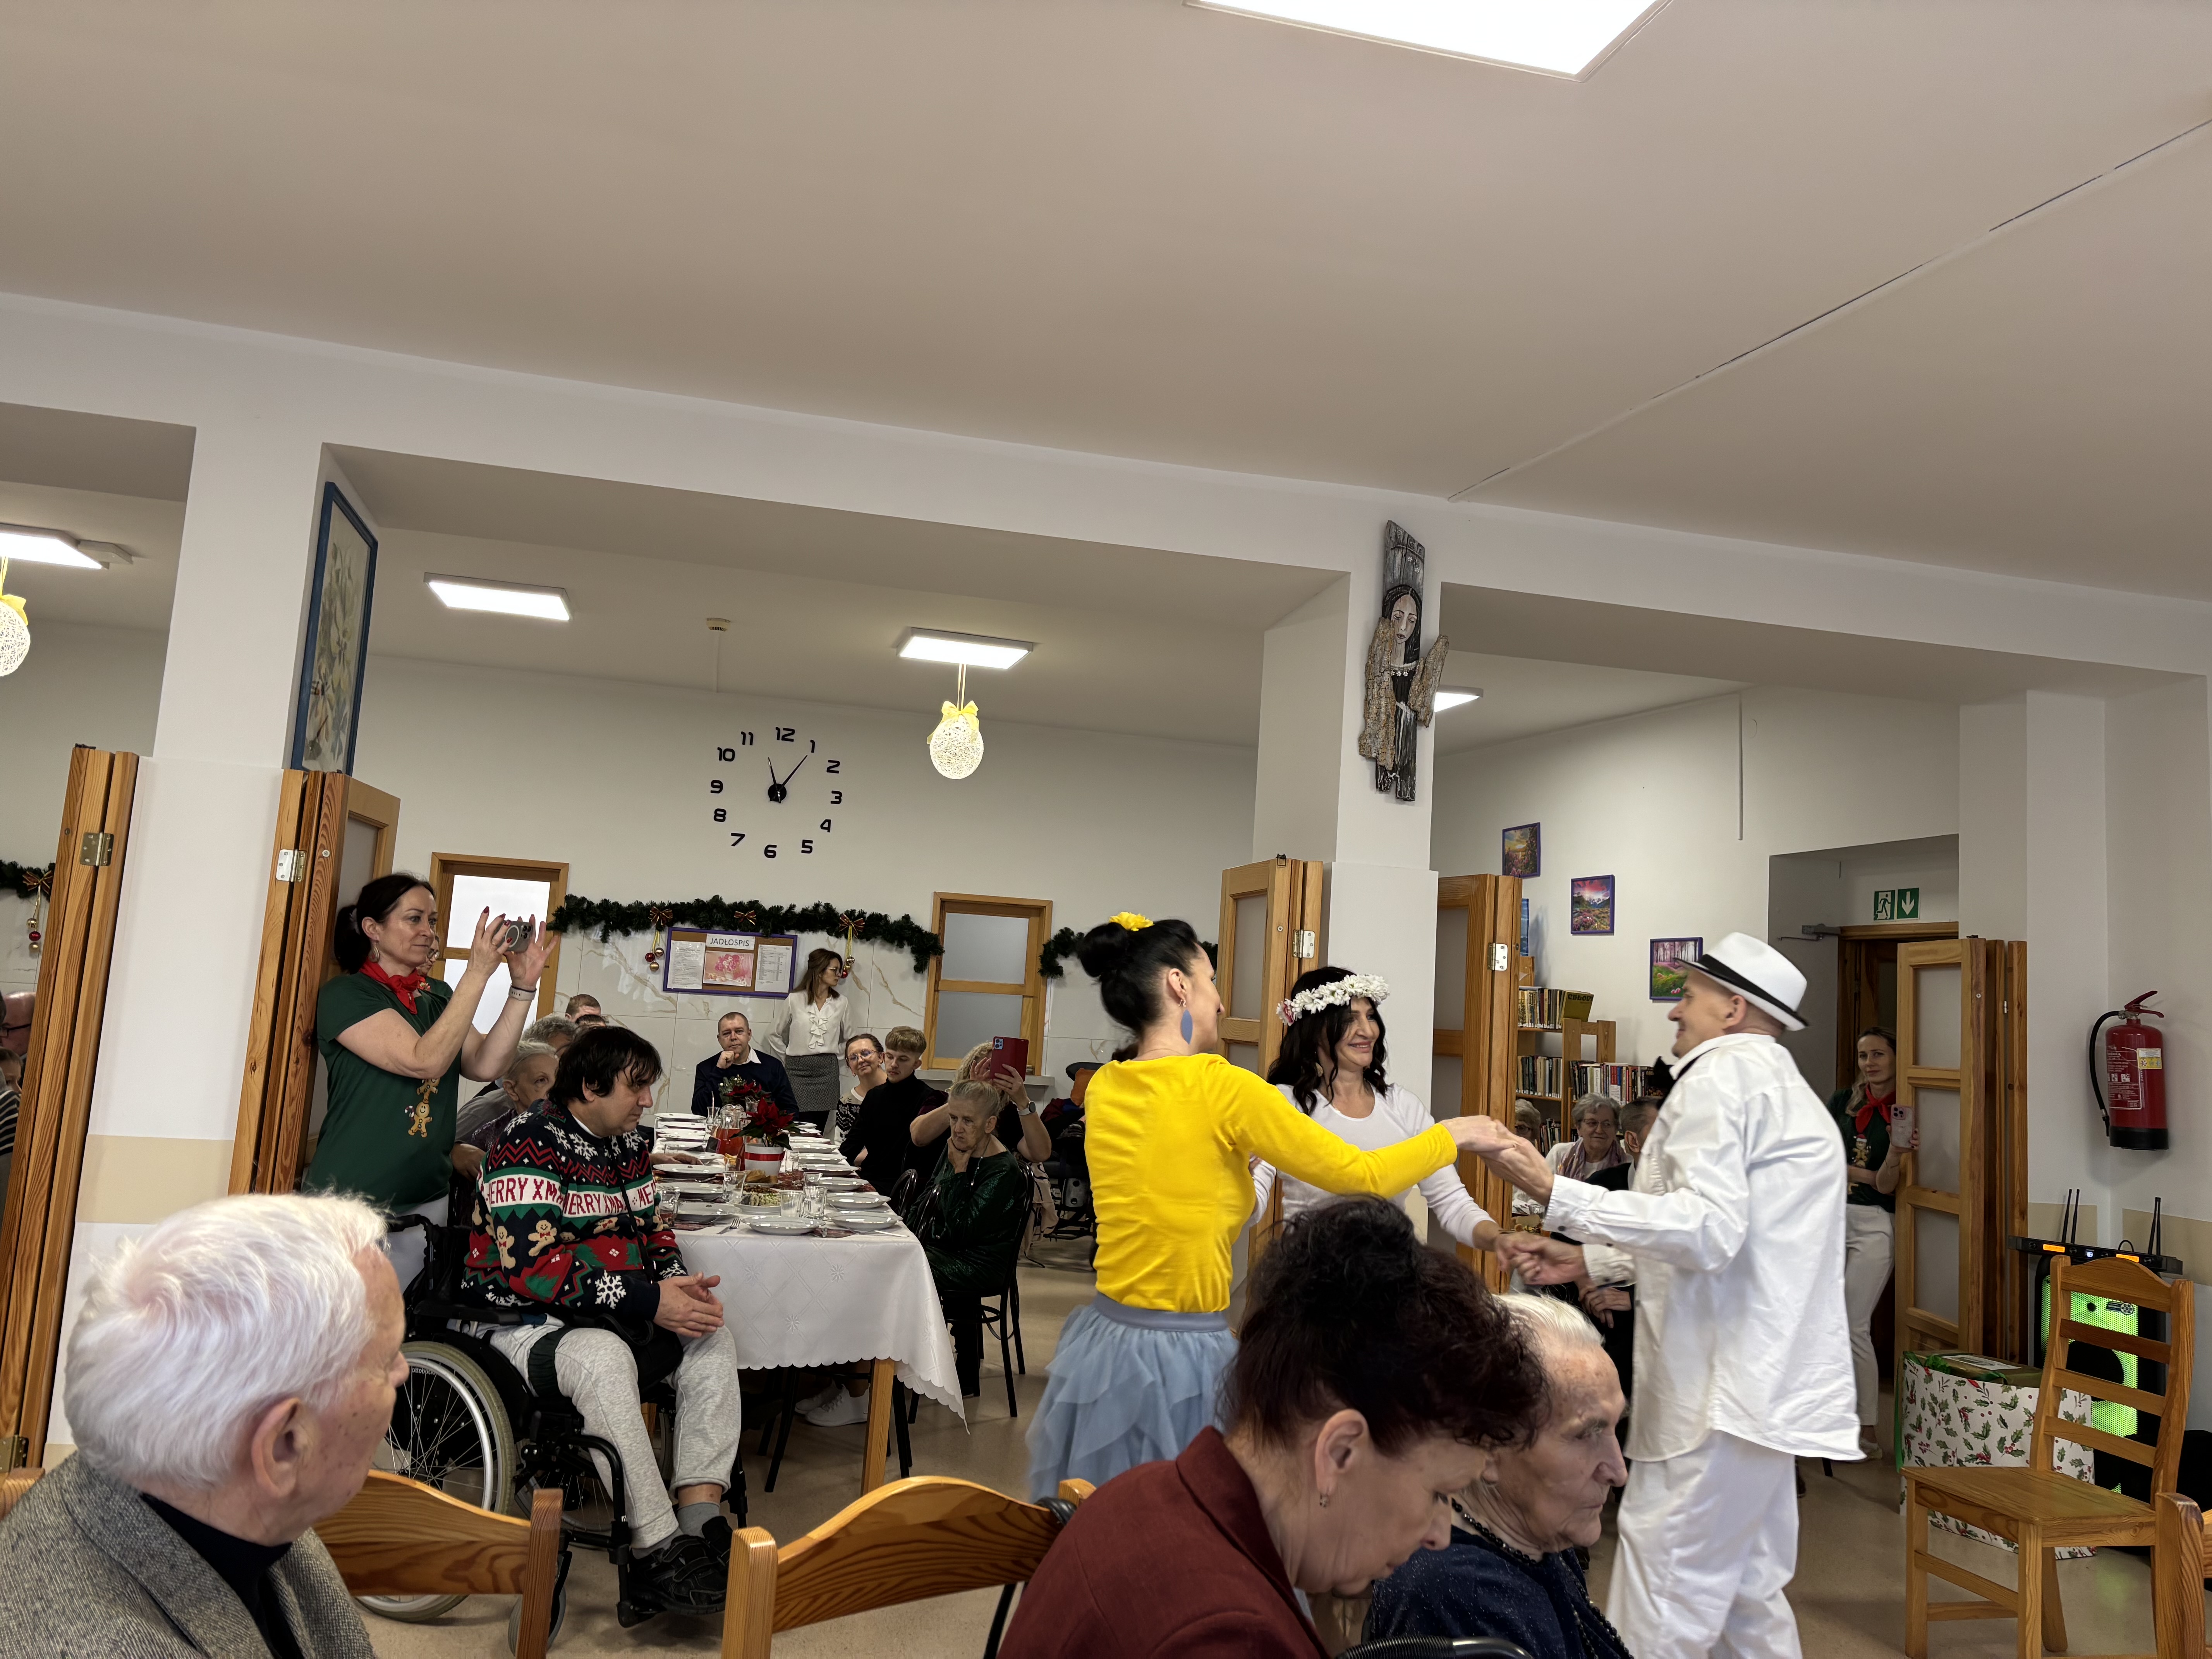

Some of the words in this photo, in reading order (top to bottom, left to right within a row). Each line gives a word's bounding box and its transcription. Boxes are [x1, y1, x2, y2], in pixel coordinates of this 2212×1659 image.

[741, 731, 754, 745] 11
[775, 726, 795, 742] 12
[810, 739, 815, 753] 1
[717, 747, 735, 762] 10
[826, 759, 840, 774] 2
[710, 780, 723, 793] 9
[830, 790, 842, 804] 3
[713, 808, 726, 822] 8
[820, 819, 831, 833] 4
[731, 833, 745, 847] 7
[801, 839, 813, 854] 5
[764, 844, 777, 859] 6
[710, 938, 749, 946] JADŁOSPIS
[489, 1177, 529, 1204] ERRY
